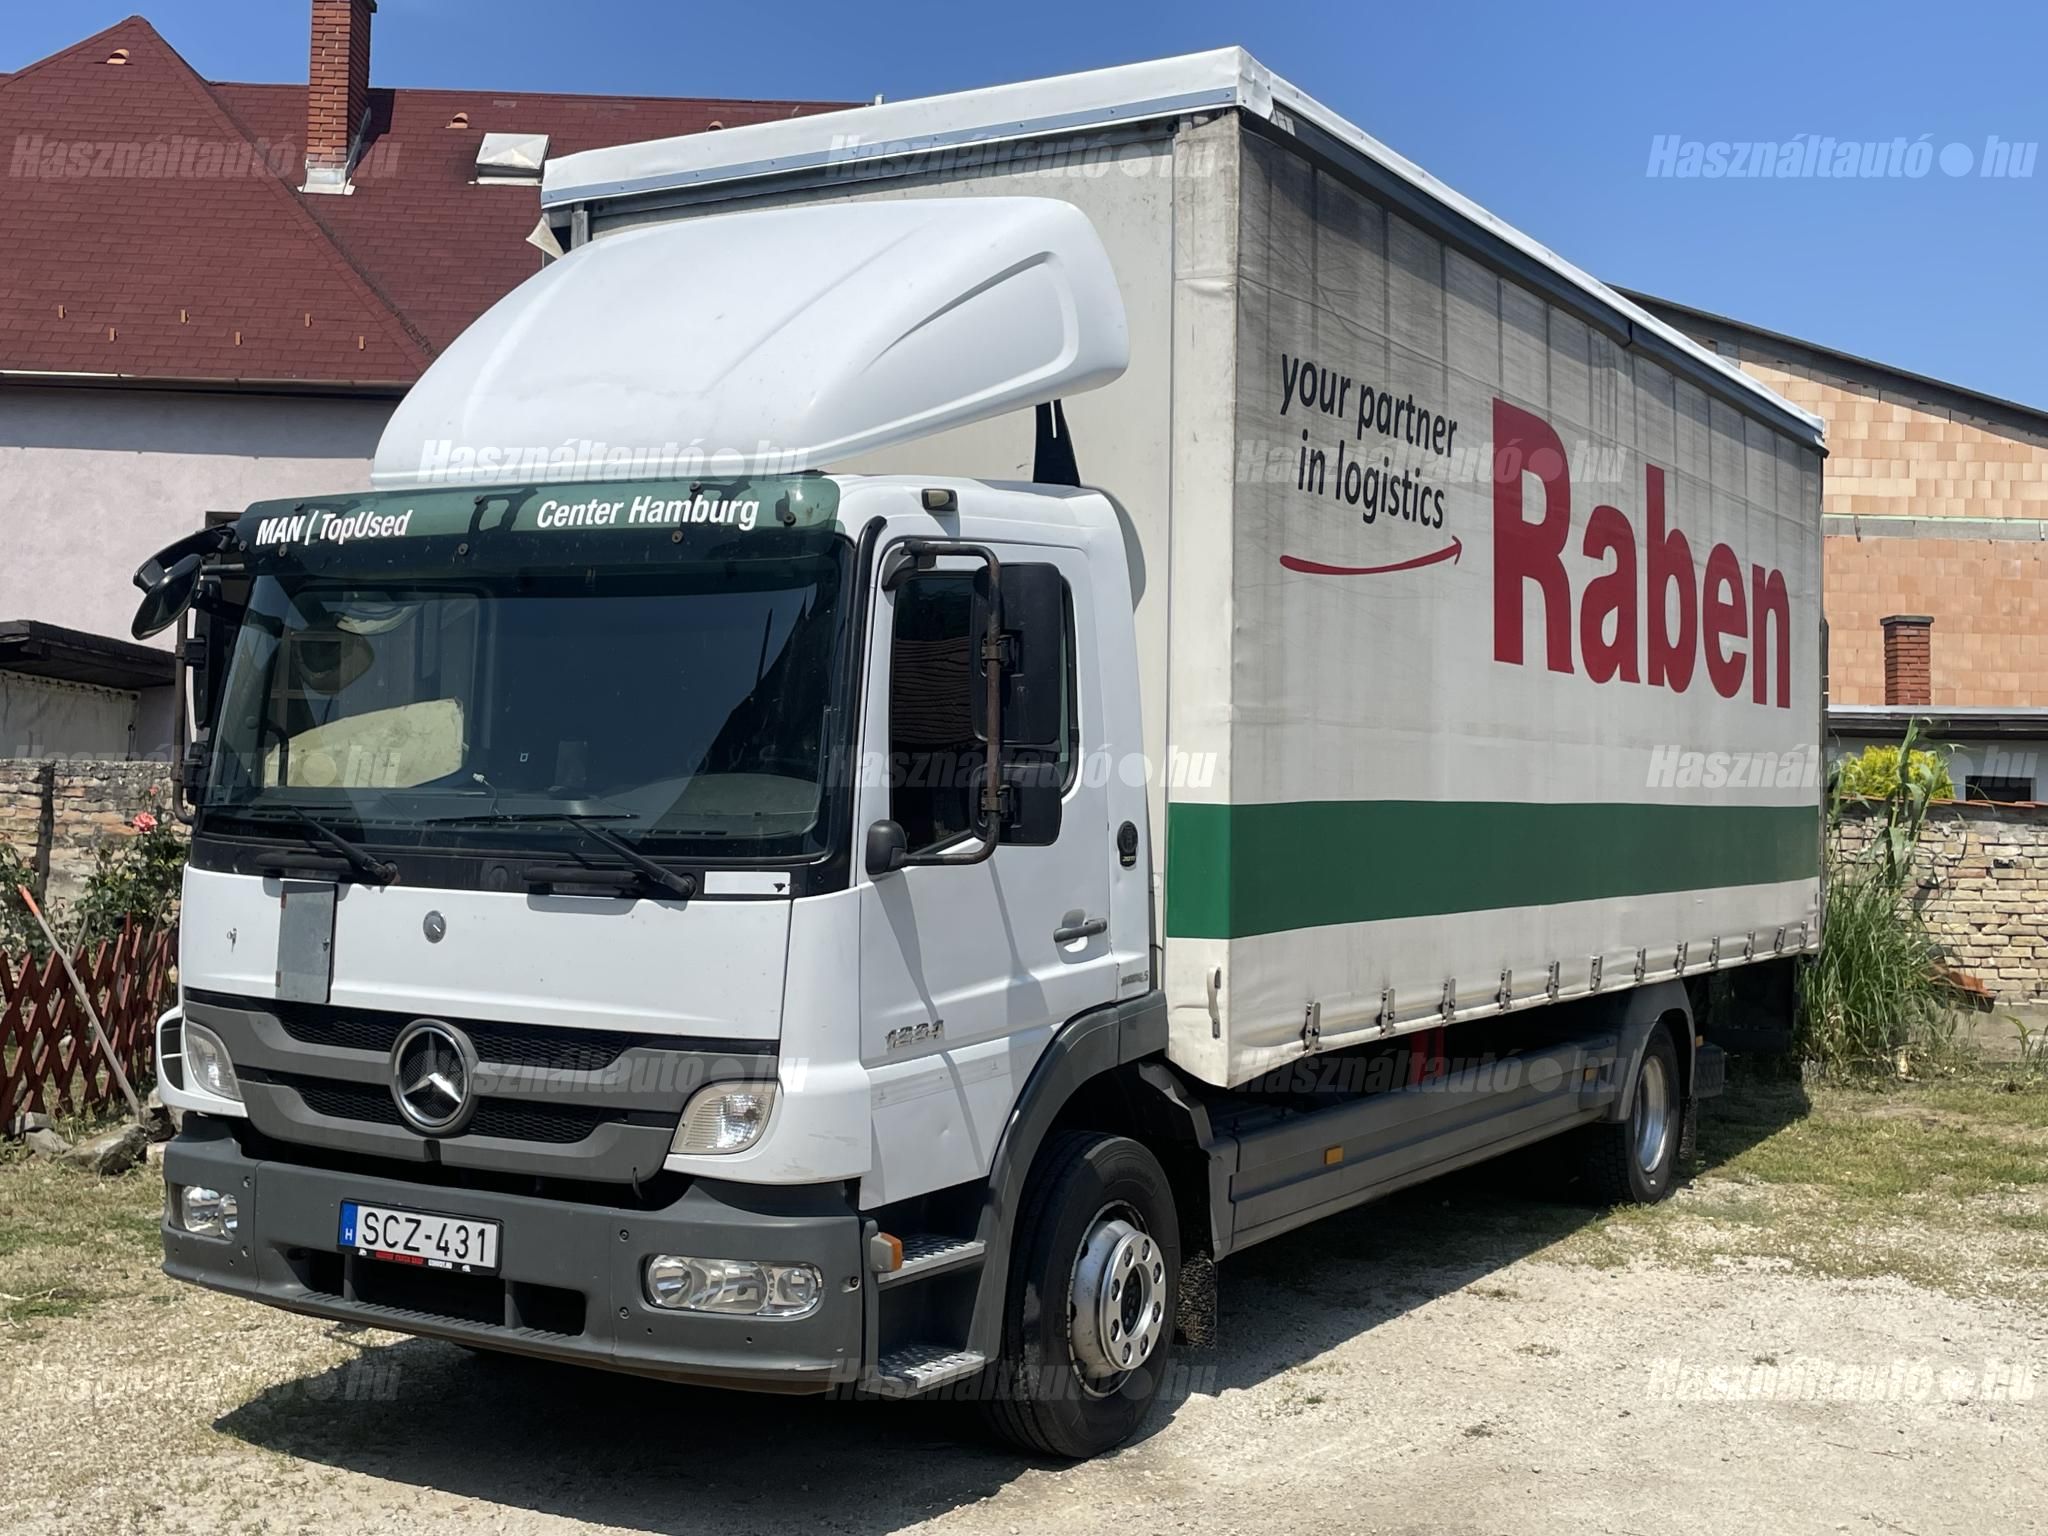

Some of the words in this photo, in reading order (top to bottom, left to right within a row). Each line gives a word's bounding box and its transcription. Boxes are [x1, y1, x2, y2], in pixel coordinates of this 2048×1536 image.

[1280, 353, 1351, 416] your
[1356, 384, 1458, 458] partner
[255, 515, 306, 546] MAN
[319, 509, 413, 545] TopUsed
[536, 498, 624, 528] Center
[628, 495, 760, 531] Hamburg
[1298, 428, 1326, 495] in
[1335, 439, 1445, 529] logistics
[1492, 396, 1791, 709] Raben
[344, 1228, 353, 1241] H
[362, 1211, 486, 1262] SCZ-431
